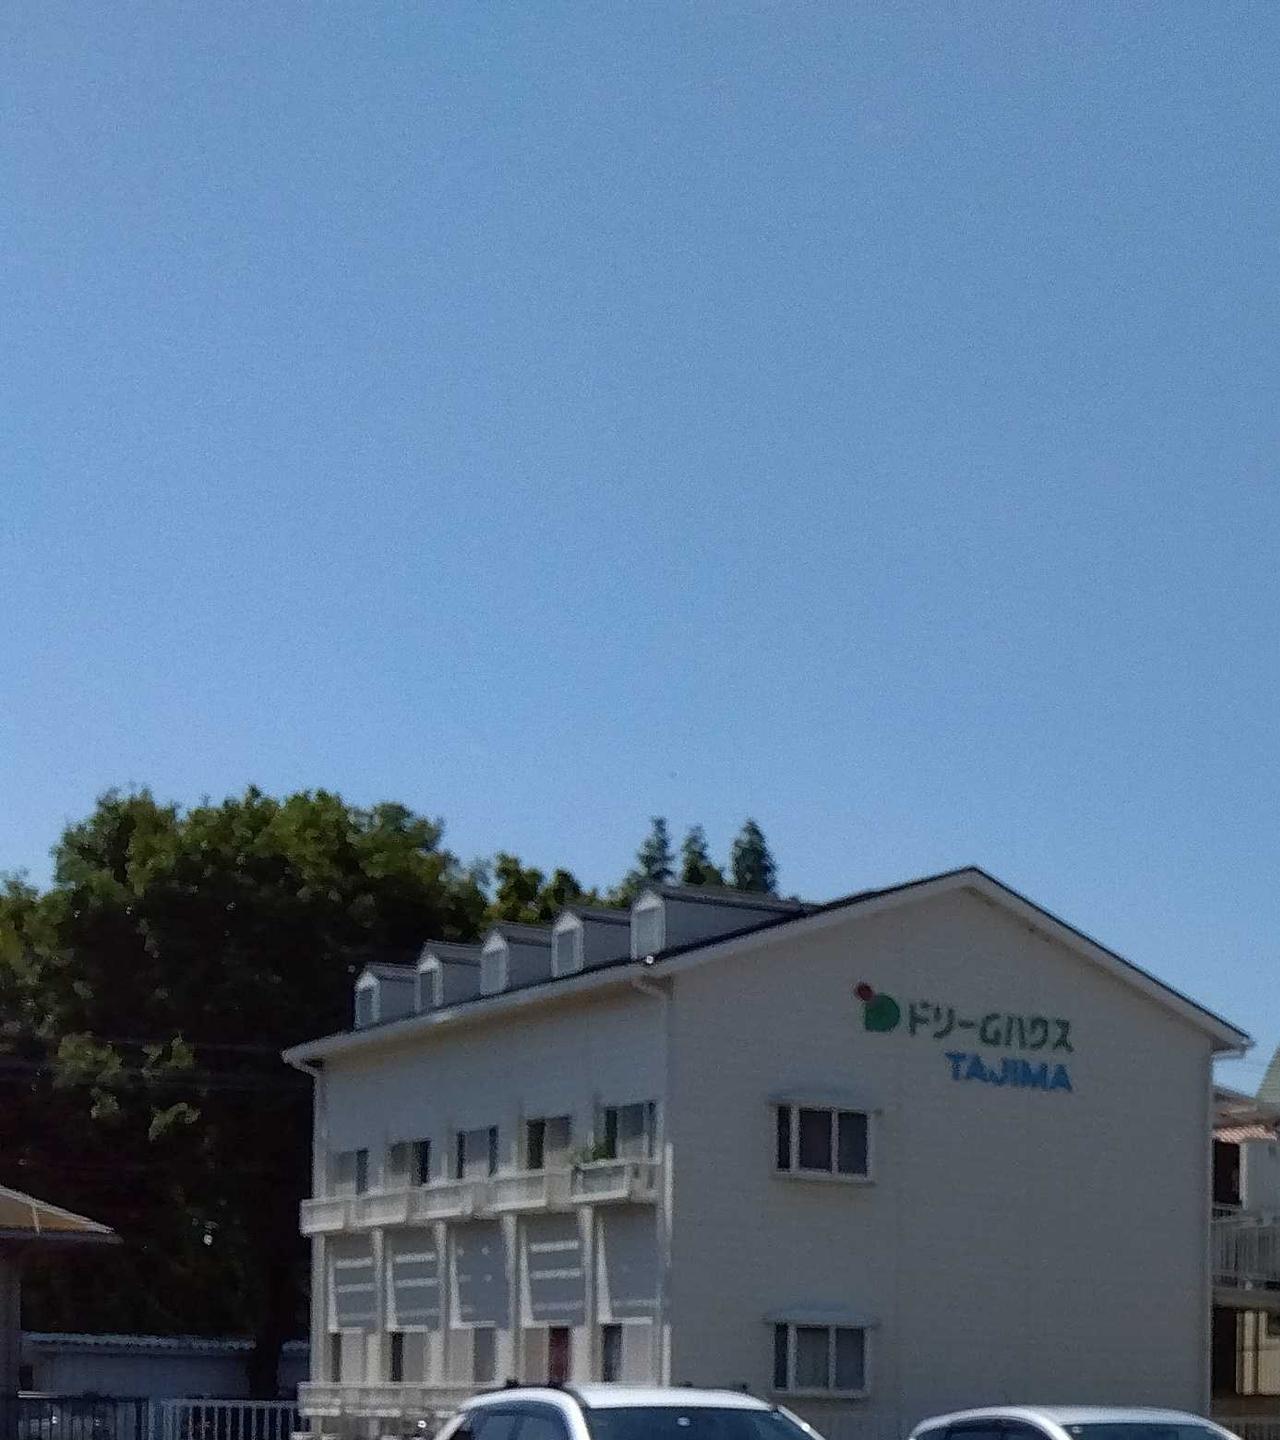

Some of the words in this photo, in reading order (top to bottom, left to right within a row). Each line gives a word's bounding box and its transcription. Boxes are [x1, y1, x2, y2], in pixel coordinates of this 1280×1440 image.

[908, 1001, 1074, 1052] ドリーGハウス
[945, 1051, 1073, 1092] TAJIMA
